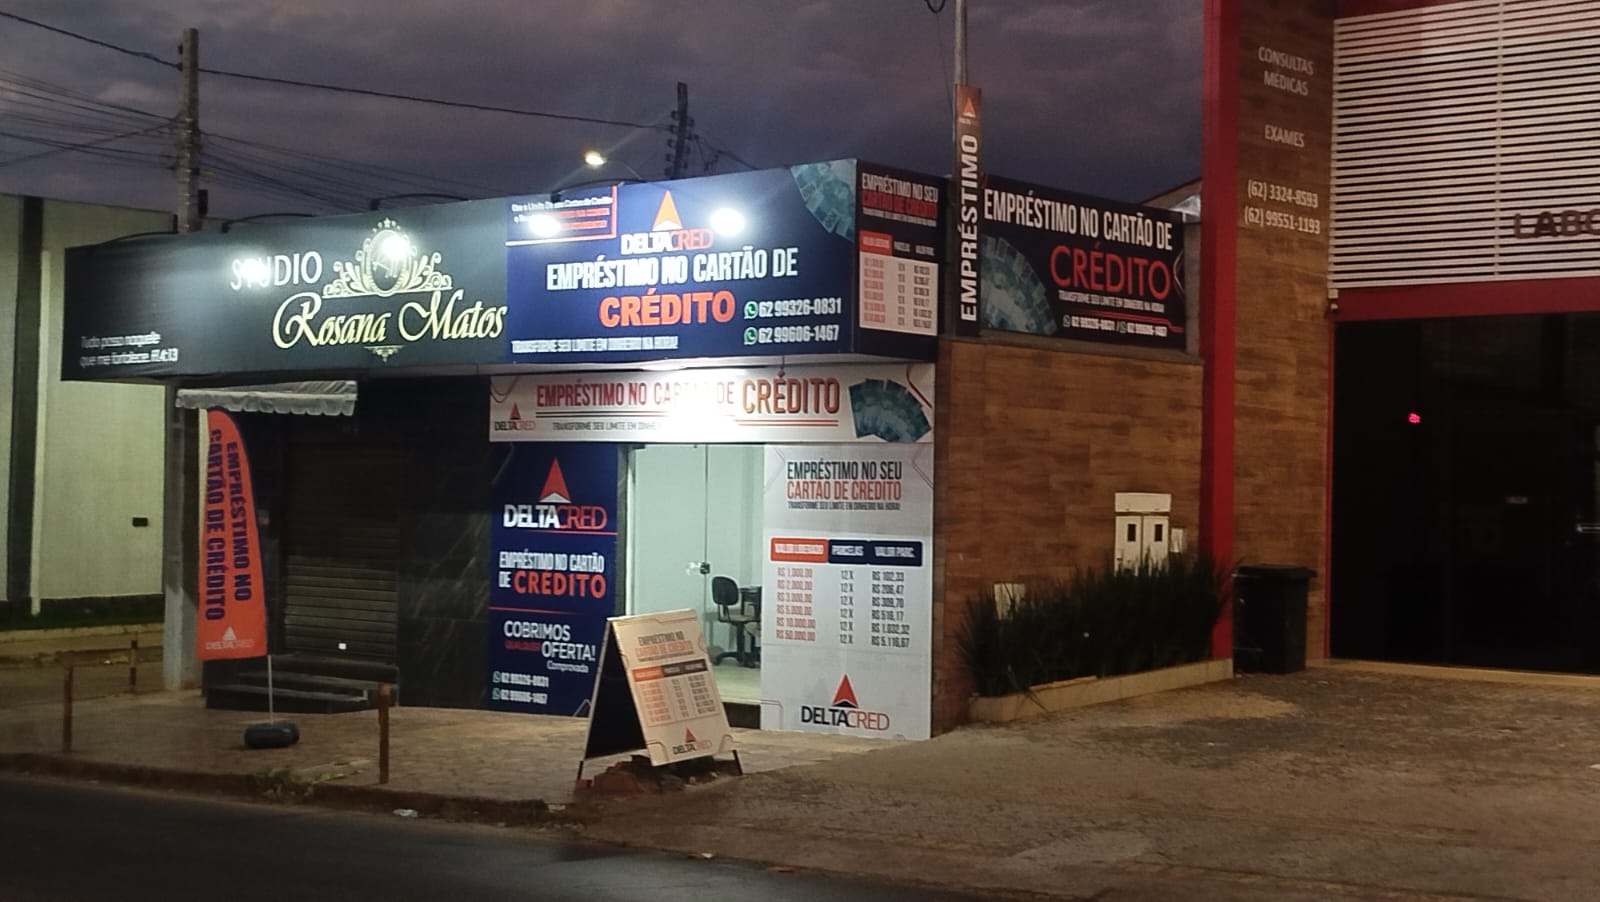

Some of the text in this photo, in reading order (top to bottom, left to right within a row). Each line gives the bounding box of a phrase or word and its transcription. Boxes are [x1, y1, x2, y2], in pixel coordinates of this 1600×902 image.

[1258, 46, 1314, 77] CONSULTAS
[1263, 70, 1309, 97] MÉDICAS
[1264, 124, 1305, 148] EXAMES
[862, 172, 939, 202] EMPRÉSTIMO NO SEU
[1247, 178, 1319, 209] (62) 3324-8593
[957, 135, 978, 321] EMPRÉSTIMO
[984, 190, 1173, 251] EMPRÉSTIMO NO CARTÃO DE
[1244, 205, 1321, 236] (62) 99551-1193
[621, 228, 714, 255] DELTACRED
[230, 251, 323, 291] SUDIO
[547, 247, 798, 291] EMPRÉSTIMO NO CARTÃO DE
[1050, 241, 1171, 299] CRÉDITO
[272, 288, 509, 350] Rosana Matos
[599, 289, 736, 328] CRÉDITO
[759, 297, 842, 318] 62 99326-0831
[758, 324, 840, 344] 62 99606-1467
[536, 375, 841, 415] EMPRÉSTIMO NO CAR DE CRÉDITO
[787, 458, 903, 481] EMPRÉSTIMO NO SEU
[834, 480, 848, 501] DE
[205, 428, 226, 622] CARTÃO DE CRÉDITO
[226, 440, 252, 601] EMPRÉSTIMO NO
[503, 504, 607, 531] DELTACRED
[499, 548, 605, 574] EMPRÉSTIMO NO CARTÃO
[498, 568, 607, 599] DE CRÉDITO
[503, 620, 571, 642] COBRIMOS
[541, 641, 596, 662] OFERTA!
[801, 705, 890, 732] DELTACRED
